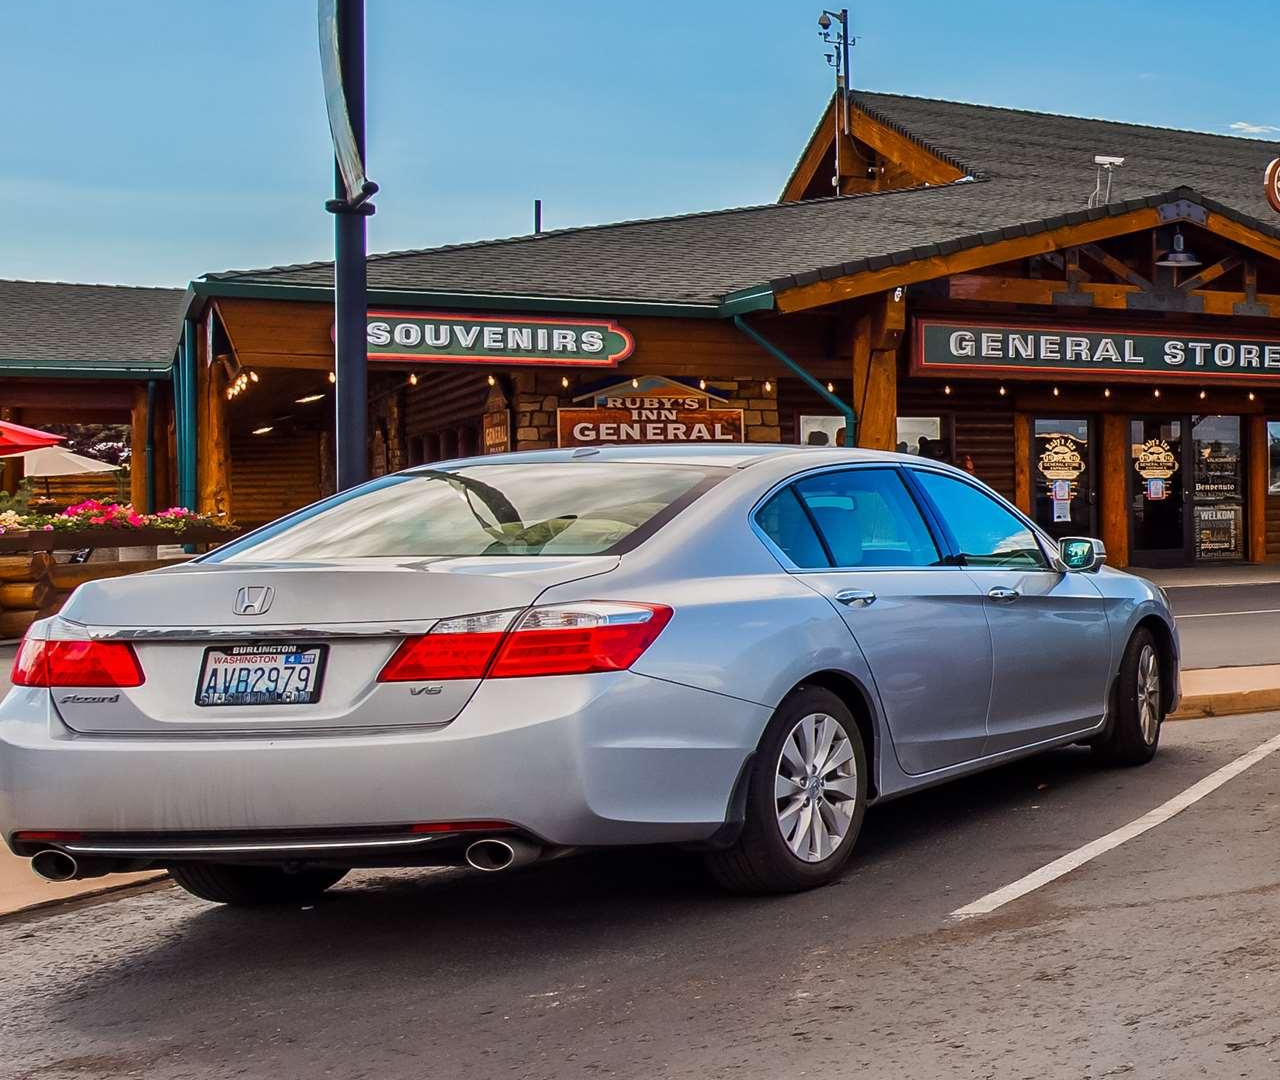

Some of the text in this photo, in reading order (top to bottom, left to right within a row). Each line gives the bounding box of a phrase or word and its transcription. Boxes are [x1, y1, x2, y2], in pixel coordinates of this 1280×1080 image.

[367, 322, 604, 353] SOUVENIRS
[949, 330, 1144, 364] GENERAL
[606, 397, 700, 409] RUBY'S
[631, 409, 678, 420] INN
[573, 423, 734, 441] GENERAL
[1200, 510, 1235, 520] WELKOM
[232, 645, 297, 654] BURLINGTON
[214, 655, 278, 665] WASHINGTON
[205, 666, 311, 694] AVB2979
